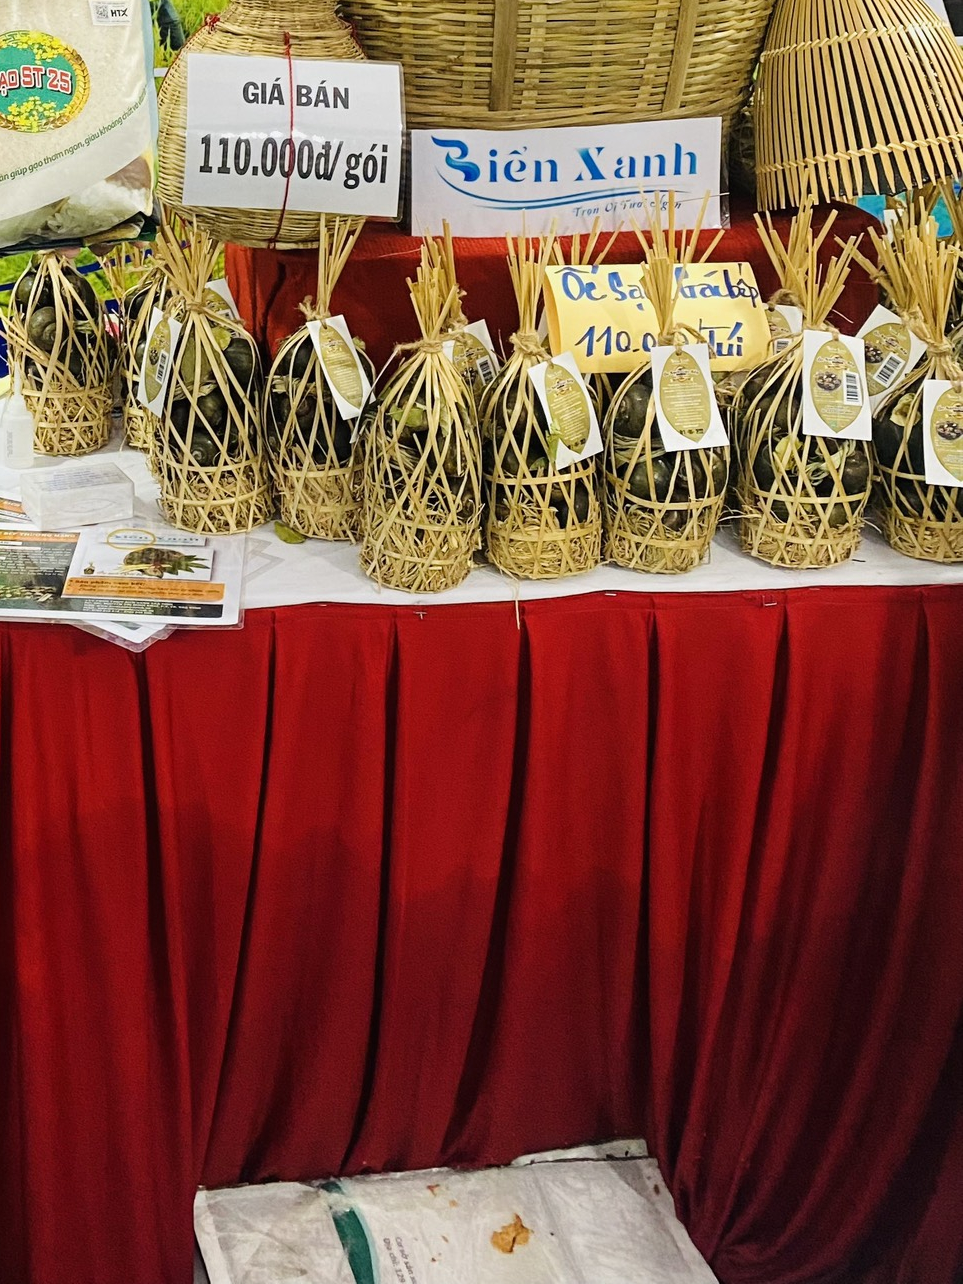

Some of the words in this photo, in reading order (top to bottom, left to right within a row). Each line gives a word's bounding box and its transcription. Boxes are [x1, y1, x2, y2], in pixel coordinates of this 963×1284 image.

[110, 7, 128, 17] HTX
[20, 64, 45, 90] ST
[47, 67, 73, 95] 25
[242, 77, 285, 106] GIÁ
[295, 79, 350, 110] BÁN
[10, 166, 28, 181] giúp
[28, 160, 43, 174] gạo
[43, 151, 65, 165] thơm
[64, 140, 85, 157] ngon,
[430, 135, 559, 184] Biển
[574, 142, 698, 182] Xanh
[555, 266, 607, 301] Ốc
